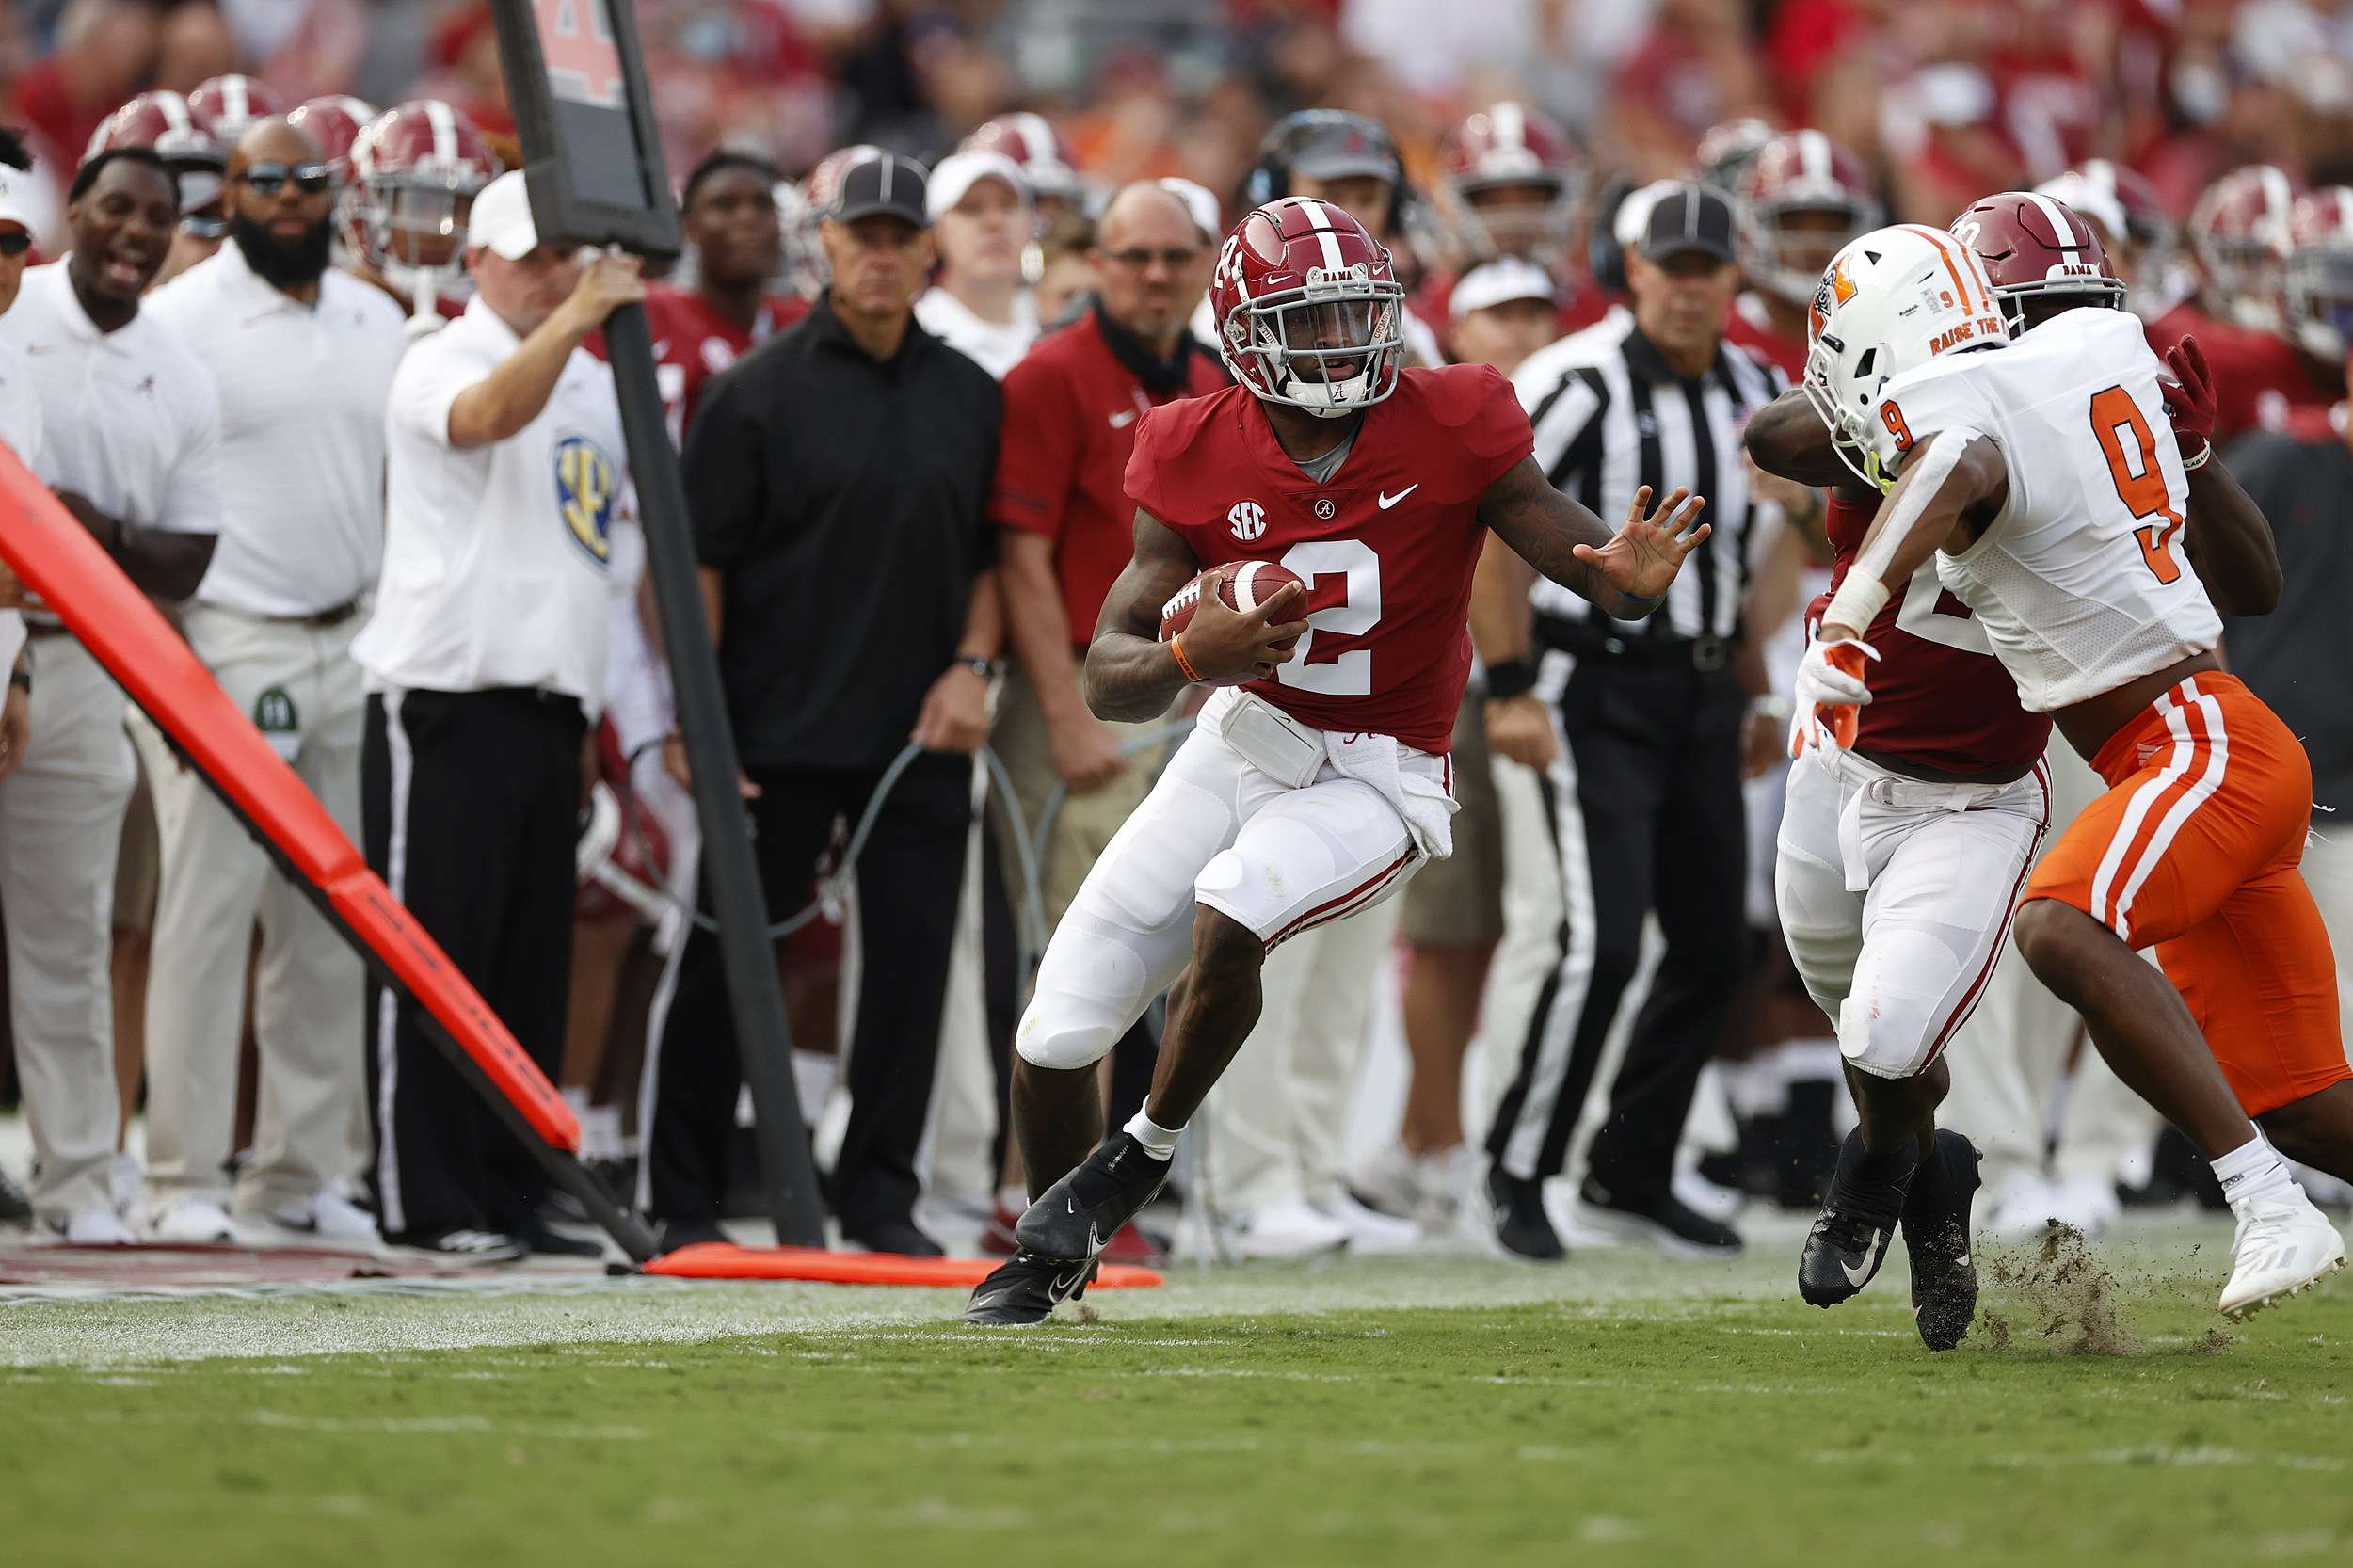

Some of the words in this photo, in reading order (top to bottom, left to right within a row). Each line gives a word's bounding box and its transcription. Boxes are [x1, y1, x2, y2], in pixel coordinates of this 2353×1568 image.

[534, 0, 623, 98] 4
[1323, 270, 1353, 282] BAMA
[2062, 265, 2092, 276] BAMA
[1939, 290, 1955, 309] 9
[1262, 327, 1276, 345] TIDE
[1929, 322, 1974, 356] RAISE
[1977, 317, 1999, 335] THE
[1880, 399, 1913, 451] 9
[2089, 384, 2184, 585] 9
[1227, 502, 1267, 541] SEC
[1276, 538, 1381, 696] 2
